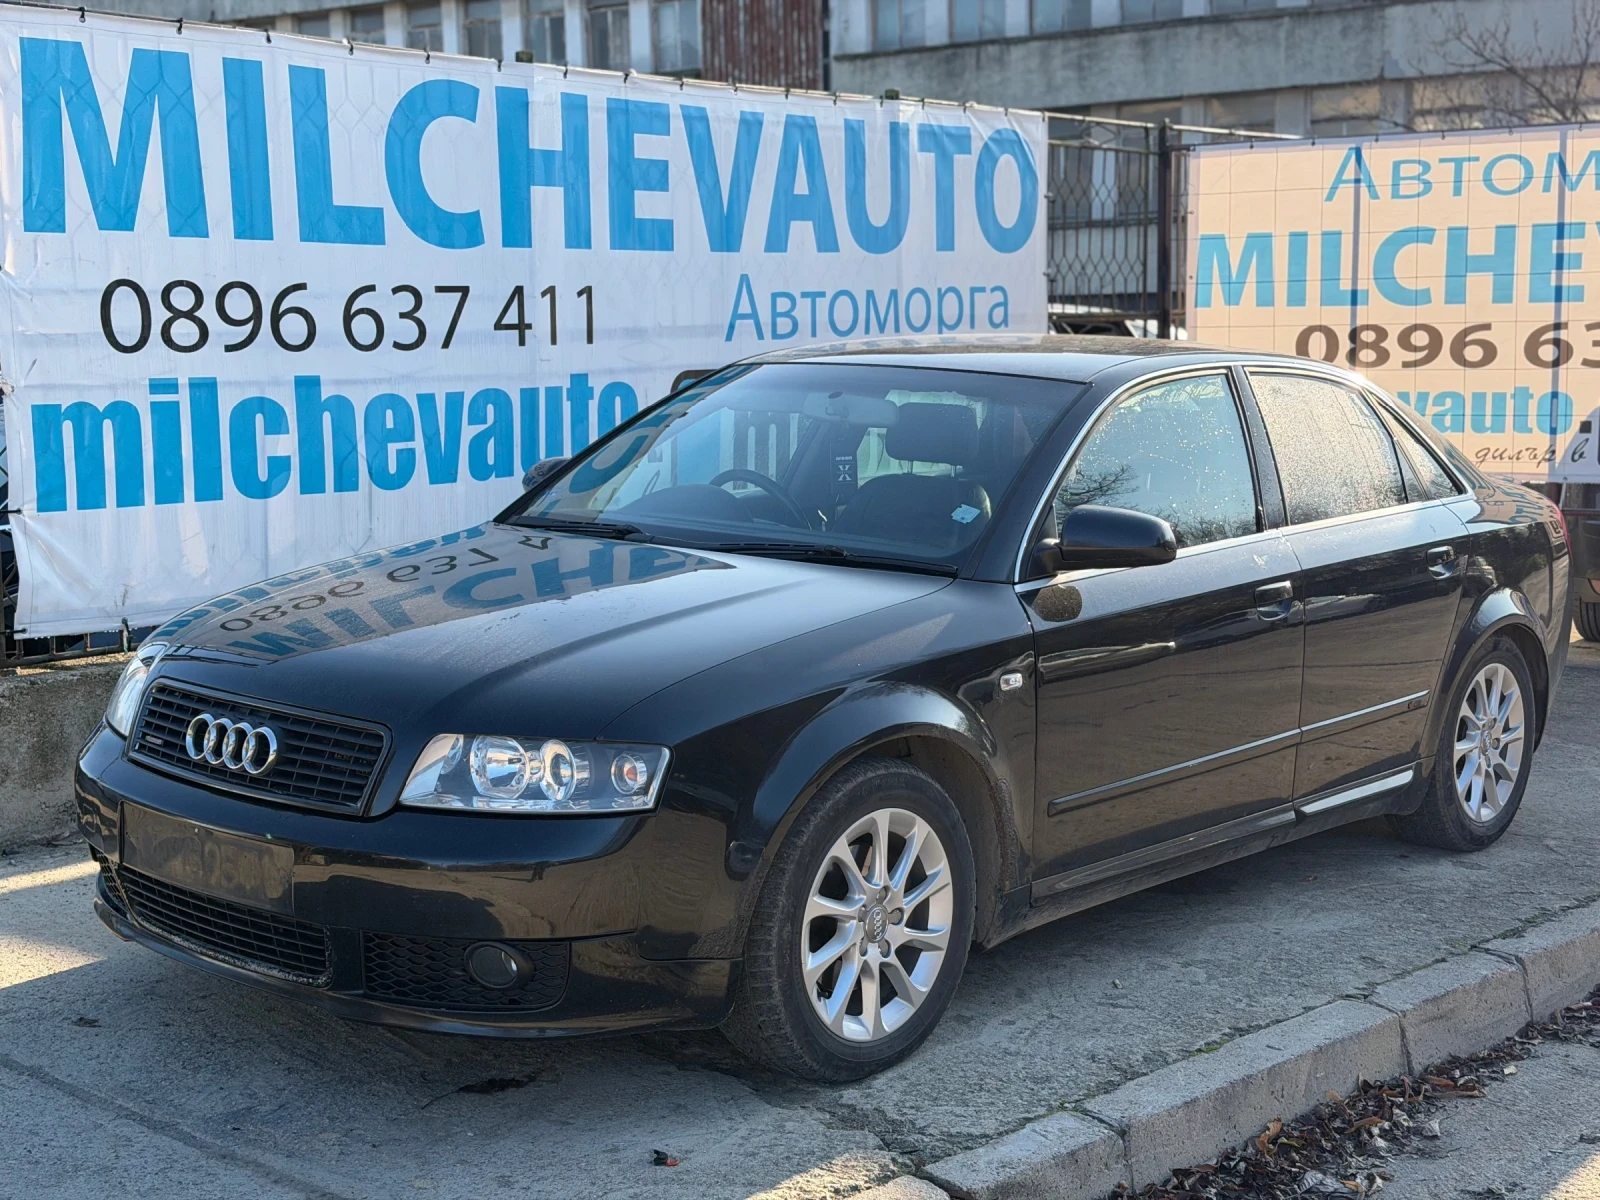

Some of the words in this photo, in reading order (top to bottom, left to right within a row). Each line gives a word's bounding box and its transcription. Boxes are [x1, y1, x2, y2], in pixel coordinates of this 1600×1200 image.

[19, 36, 1039, 254] MILCHEVAUTO
[1194, 221, 1600, 309] MILCHE
[100, 277, 317, 354] 0896
[342, 284, 470, 352] 637
[493, 284, 595, 348] 411
[724, 272, 1010, 343] Автоморга
[1295, 322, 1498, 370] 0896
